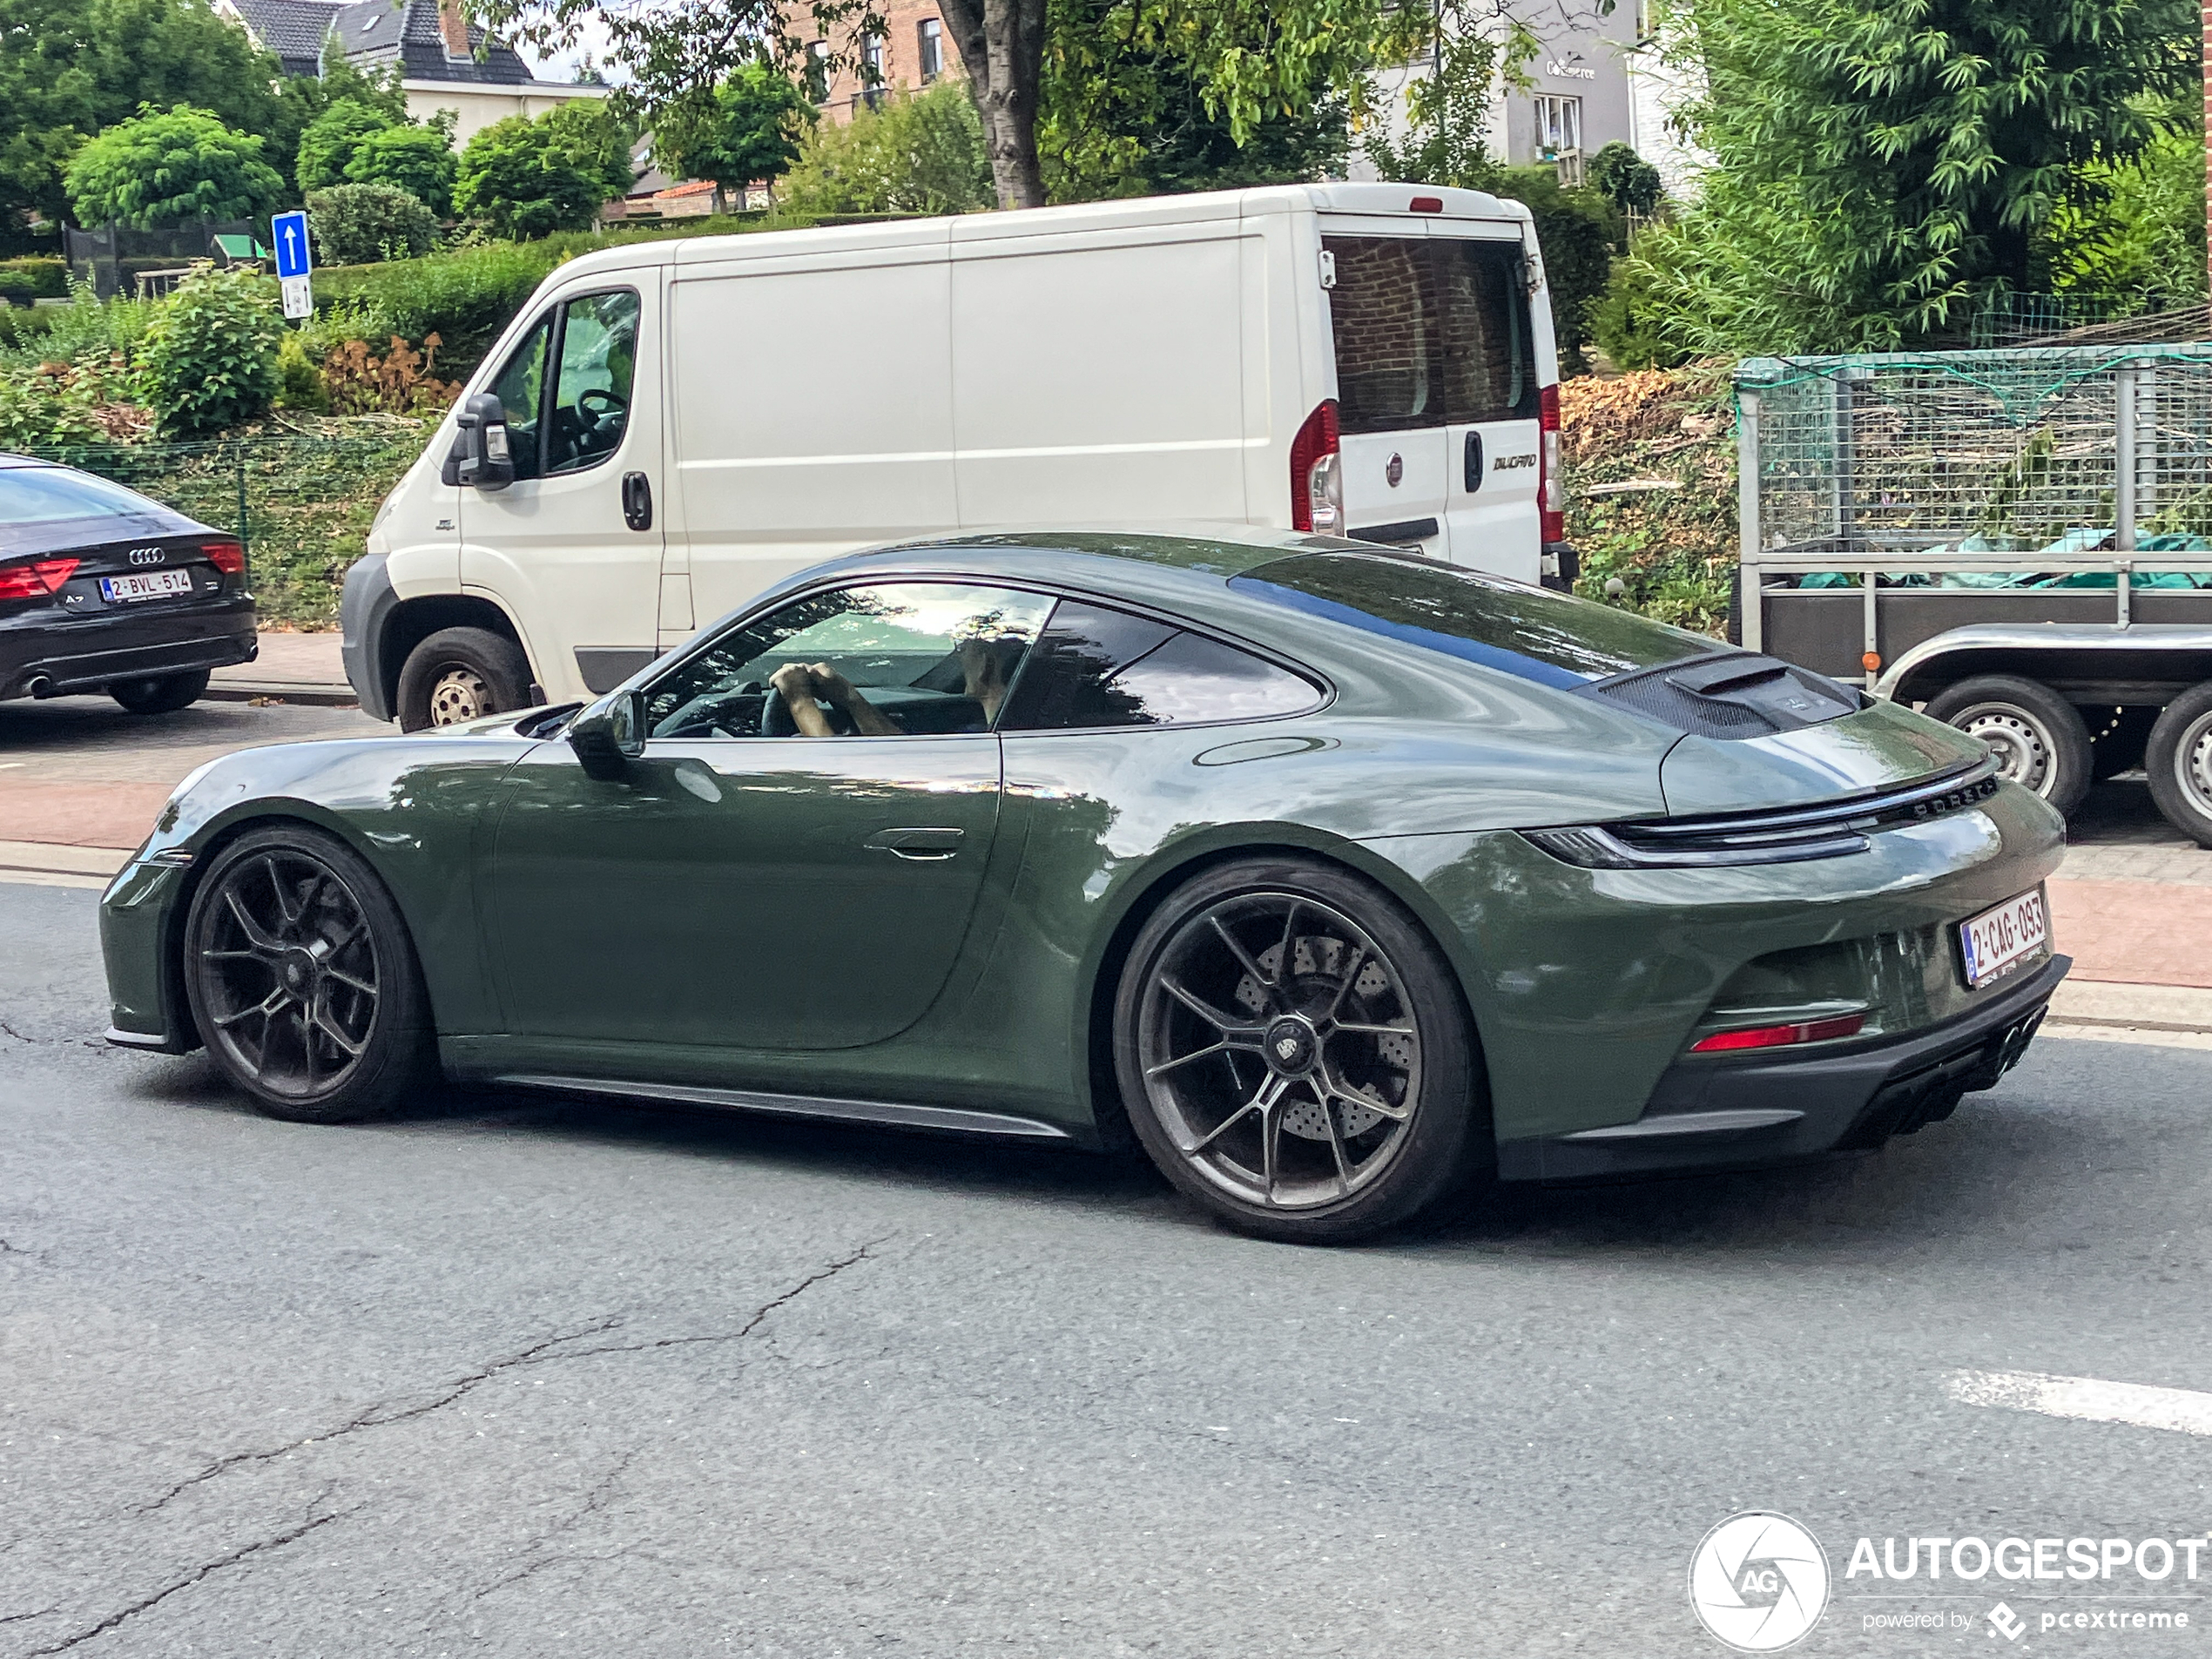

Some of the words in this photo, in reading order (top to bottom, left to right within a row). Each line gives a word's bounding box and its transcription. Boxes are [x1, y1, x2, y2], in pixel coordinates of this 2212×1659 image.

[1493, 454, 1537, 471] DUCATO
[111, 572, 190, 596] 2-BVL-514
[65, 594, 85, 604] A7
[1973, 897, 2043, 969] 2-CAG-093
